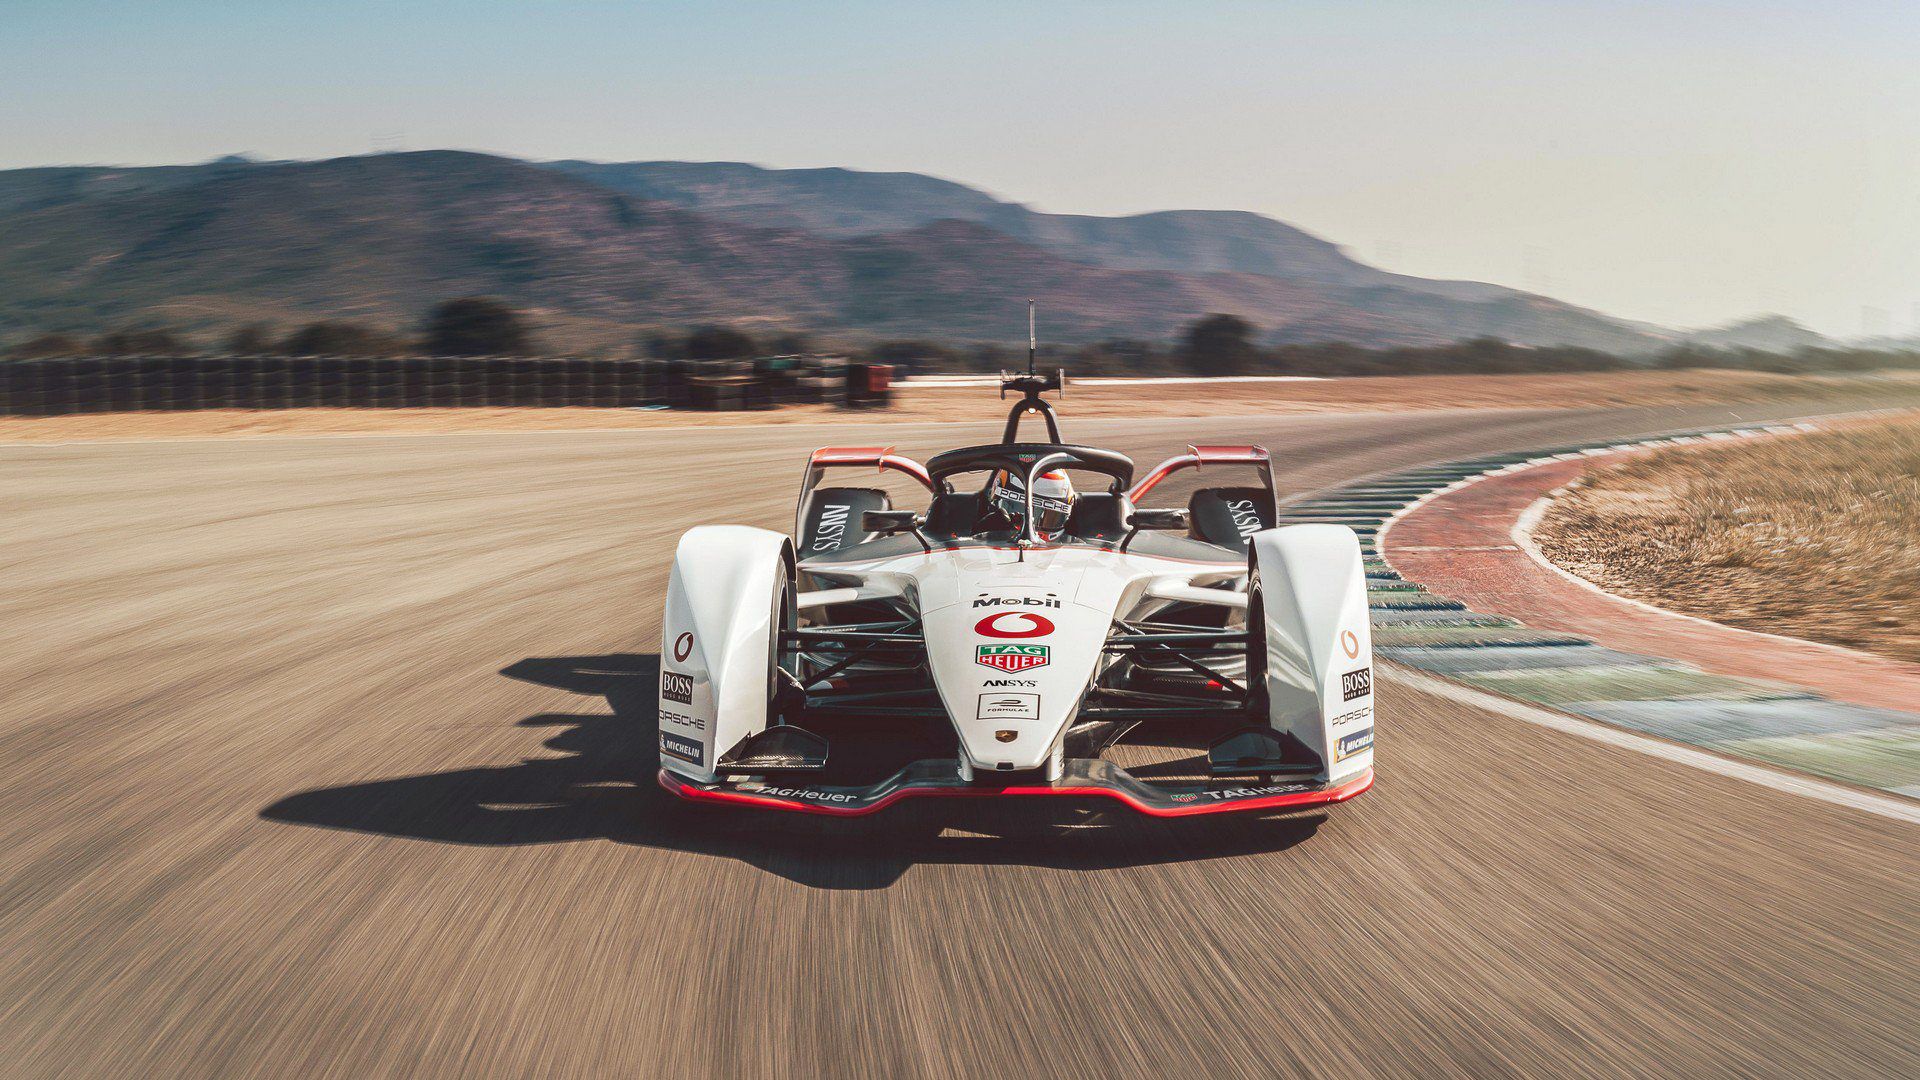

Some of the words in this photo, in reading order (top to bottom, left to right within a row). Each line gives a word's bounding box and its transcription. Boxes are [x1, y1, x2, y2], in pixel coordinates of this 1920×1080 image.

[813, 504, 851, 551] ANSYS
[973, 597, 1060, 608] Mobil
[985, 645, 1042, 655] TAG
[982, 655, 1043, 670] HEUER
[664, 674, 691, 695] BOSS
[1343, 670, 1369, 693] BOSS
[659, 709, 705, 730] ORSCHE
[1332, 706, 1374, 727] PORSCH
[667, 740, 700, 757] MICHELIN
